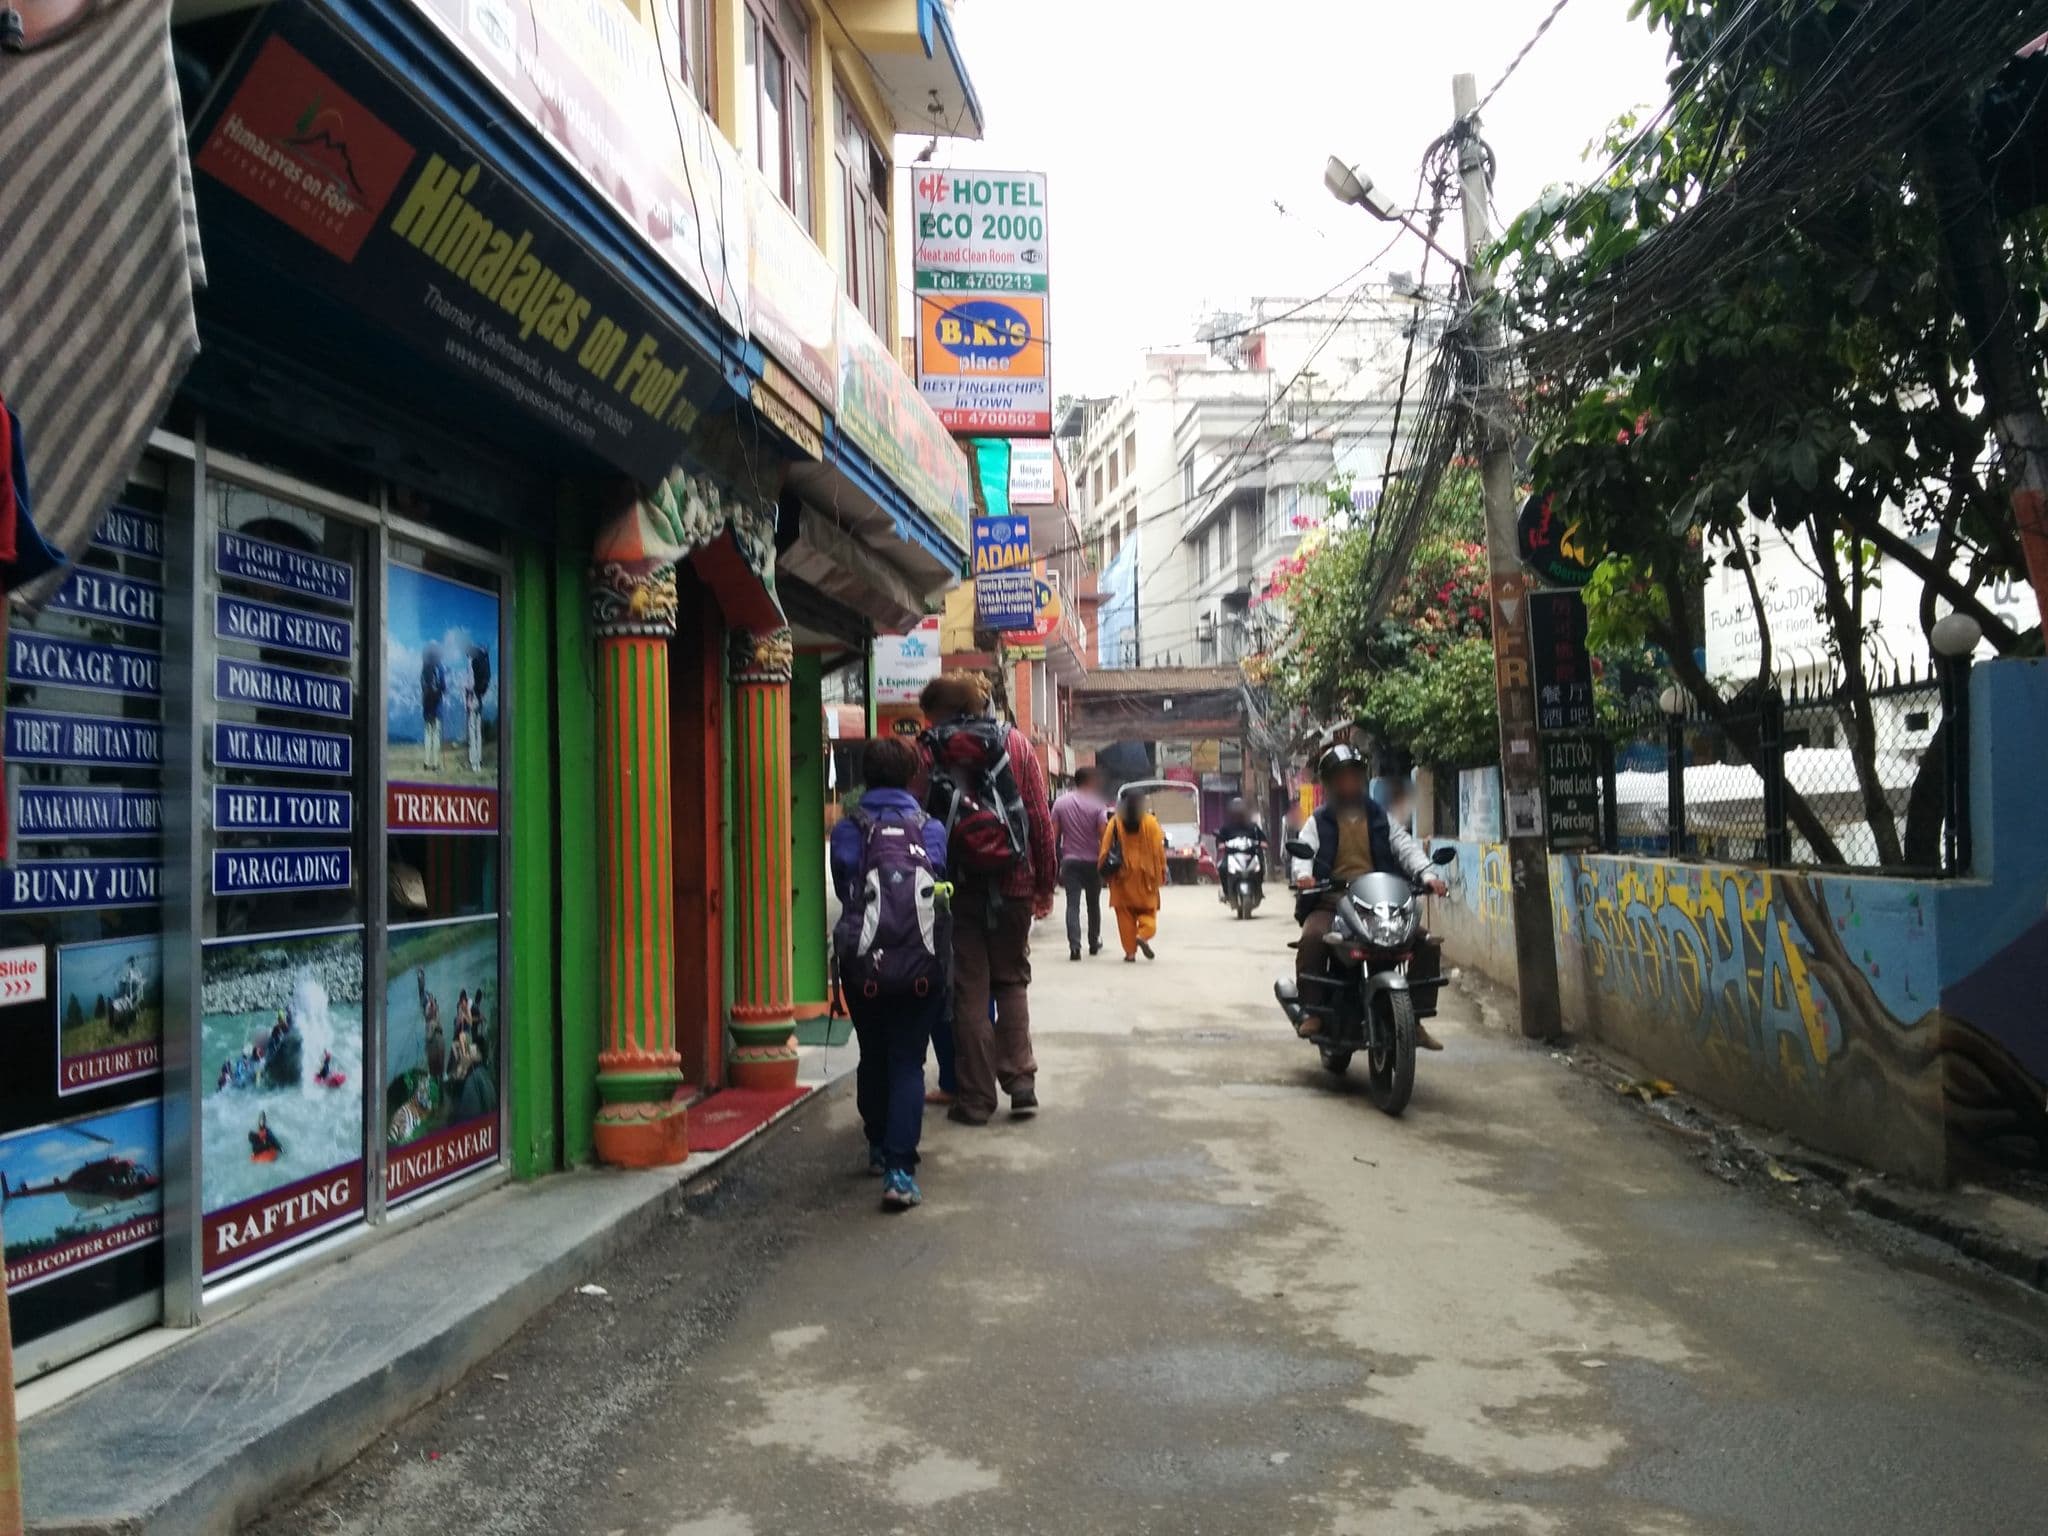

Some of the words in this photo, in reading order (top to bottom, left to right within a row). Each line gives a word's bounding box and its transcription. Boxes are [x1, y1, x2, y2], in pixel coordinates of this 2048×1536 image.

[301, 173, 322, 198] on
[953, 178, 1044, 208] HOTEL
[919, 211, 973, 240] ECO
[982, 213, 1043, 241] 2000
[920, 247, 941, 263] Neat
[943, 247, 960, 262] and
[962, 248, 988, 264] Clean
[989, 248, 1015, 264] Room
[391, 153, 592, 352] Himalayas
[577, 315, 628, 381] on
[613, 332, 689, 422] Foot
[930, 272, 961, 289] Tel:
[965, 273, 1033, 291] 4700213
[960, 351, 1011, 373] place
[922, 380, 954, 394] BEST
[957, 382, 1045, 395] FINGERCHIPS
[971, 397, 1013, 410] TOWN
[225, 536, 284, 568] FLIGHT
[287, 551, 346, 585] TICKETS
[976, 542, 1031, 573] ADAM
[228, 603, 282, 641] SIGHT
[285, 614, 343, 652] SEEING
[1734, 627, 1761, 648] Club
[15, 639, 115, 685] PACKAGE
[228, 664, 301, 705] POKHARA
[304, 678, 342, 712] TOUR
[886, 676, 930, 689] Expedition
[14, 718, 62, 754] TIBET
[72, 723, 132, 759] BHUTAN
[227, 729, 251, 760] MT.
[253, 732, 308, 766] KAILASH
[310, 737, 342, 768] TOUR
[1549, 740, 1593, 769] TATTOO
[1550, 774, 1574, 797] Dread
[1575, 773, 1593, 796] Lock
[228, 793, 282, 825] HELI
[286, 796, 342, 826] TOUR
[394, 792, 491, 826] TREKKING
[1551, 811, 1595, 833] Piercing
[14, 867, 100, 902] BUNJY
[227, 854, 342, 887] PARAGLADING
[0, 959, 38, 978] Slide
[67, 1051, 134, 1084] CULTURE
[387, 1144, 446, 1192] JUNGLE
[447, 1125, 493, 1166] SAFARI
[214, 1177, 351, 1256] RAFTING
